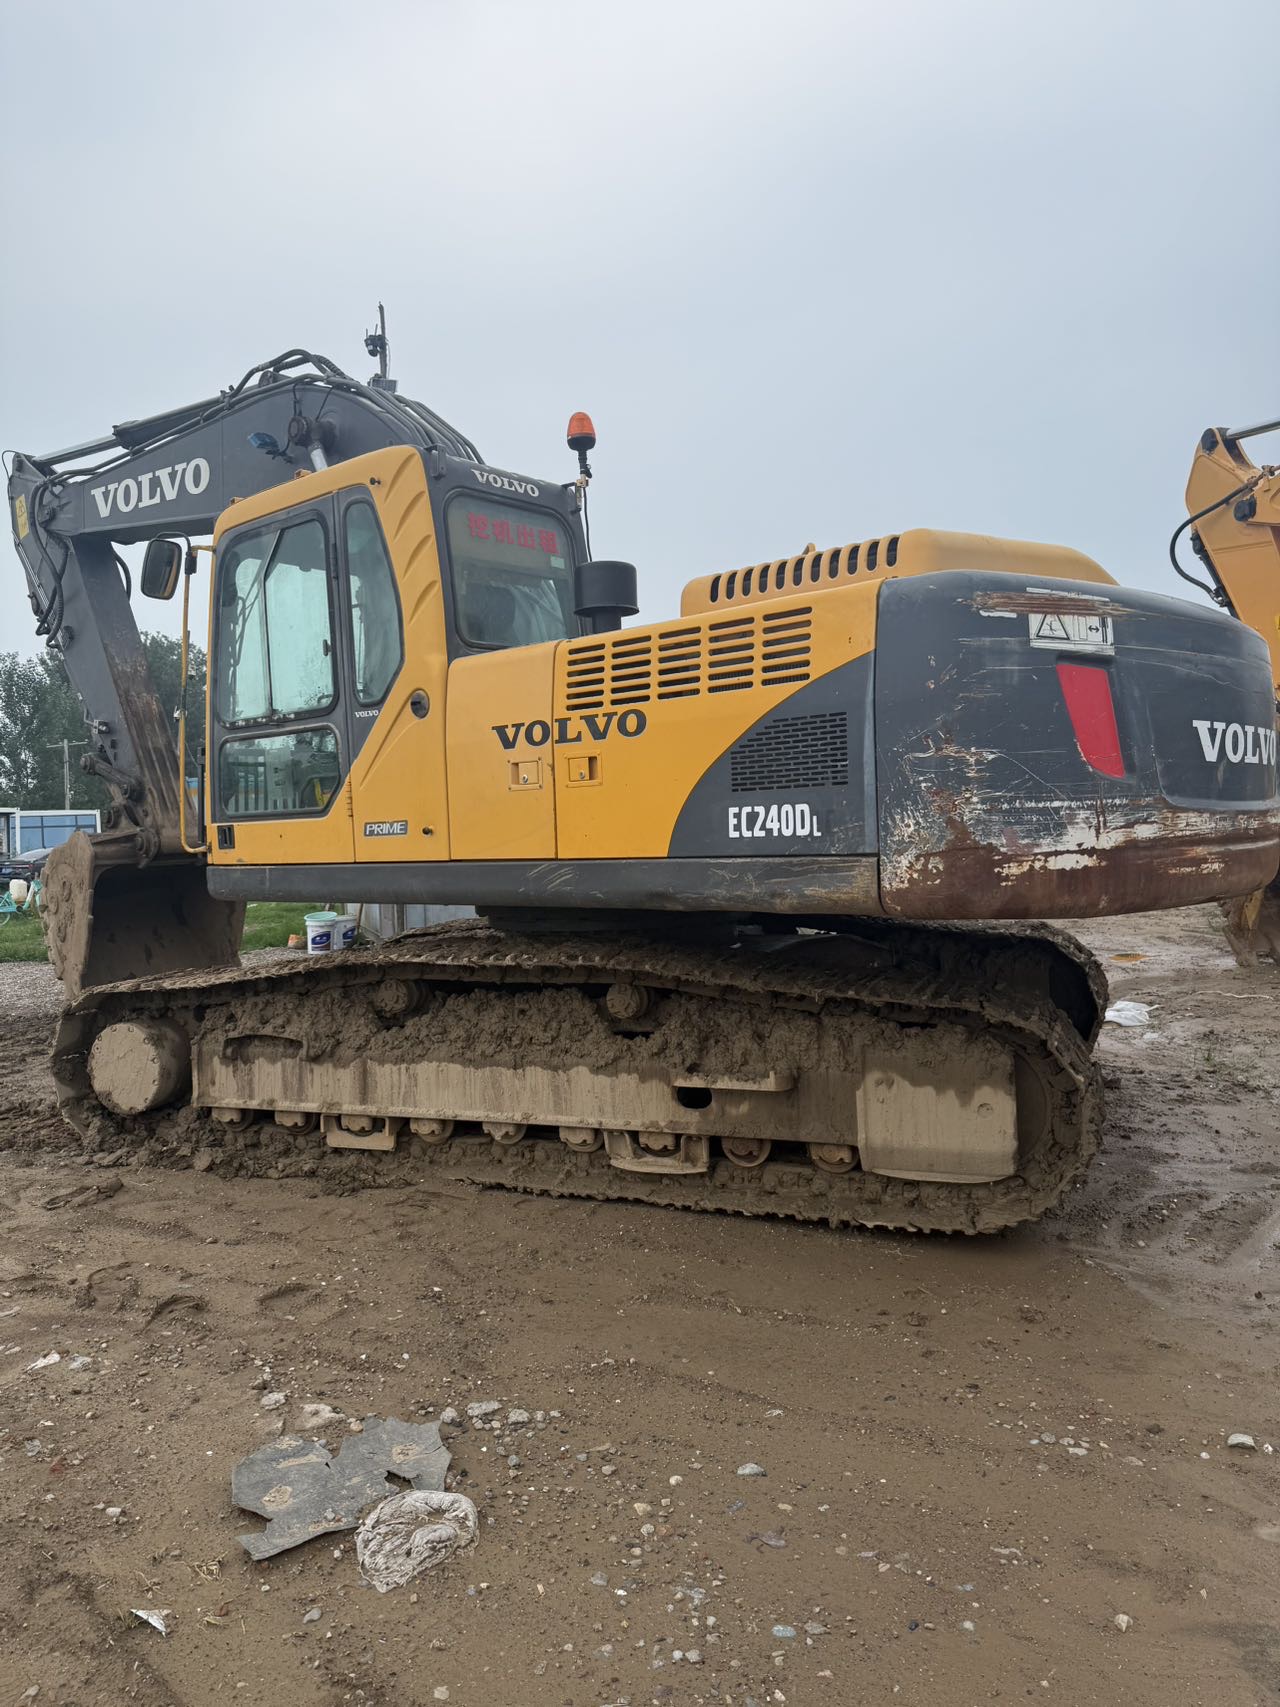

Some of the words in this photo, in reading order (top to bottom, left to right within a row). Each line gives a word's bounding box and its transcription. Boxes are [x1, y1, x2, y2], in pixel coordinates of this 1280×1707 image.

[91, 458, 210, 518] VOLVO
[471, 469, 539, 497] VOLVO
[468, 512, 560, 555] 挖机出租
[355, 710, 379, 718] VOLVO
[492, 709, 647, 750] VOLVO
[1192, 720, 1276, 766] VOLVO
[366, 822, 406, 835] PRIME
